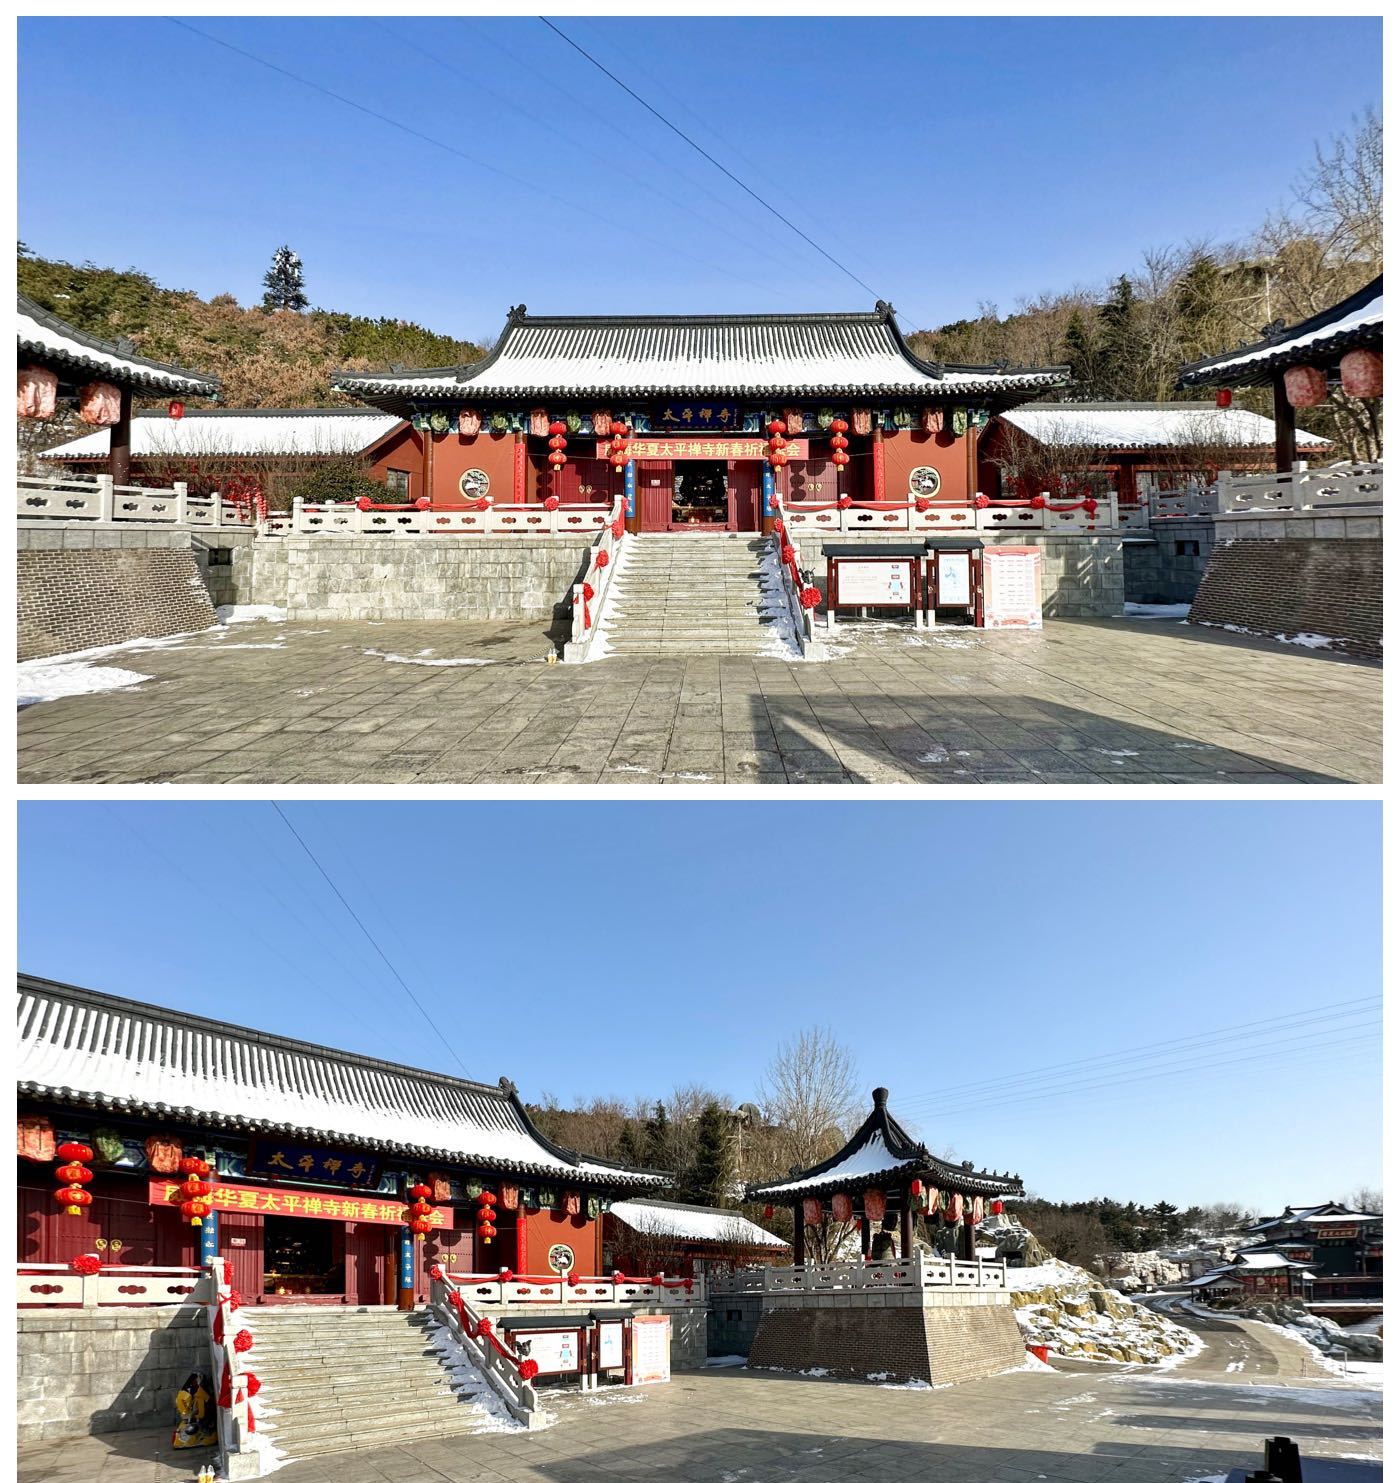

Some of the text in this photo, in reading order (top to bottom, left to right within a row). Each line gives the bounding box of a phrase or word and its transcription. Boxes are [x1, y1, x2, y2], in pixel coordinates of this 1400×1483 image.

[604, 442, 801, 457] 华夏太平禅寺新春祈会
[164, 1185, 445, 1225] 华夏太平禅寺新春祈会
